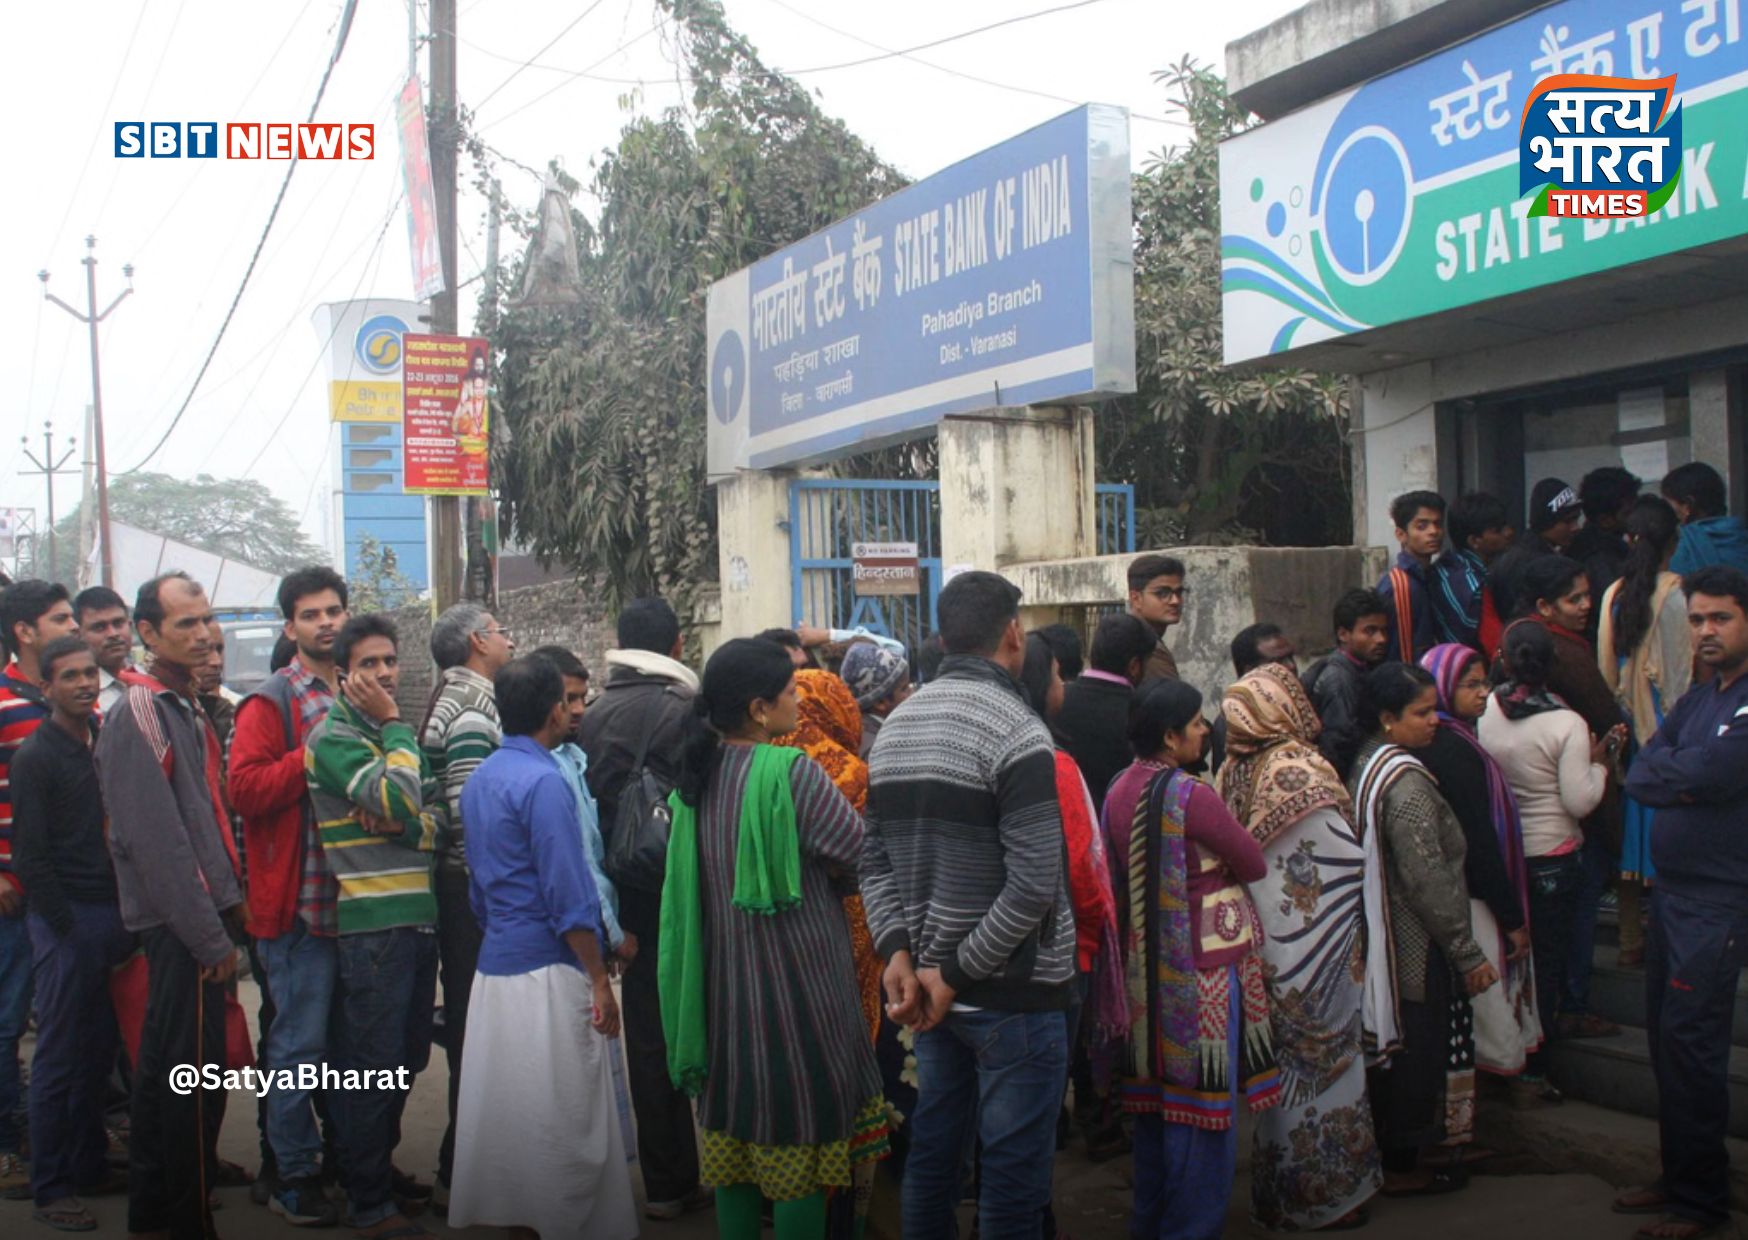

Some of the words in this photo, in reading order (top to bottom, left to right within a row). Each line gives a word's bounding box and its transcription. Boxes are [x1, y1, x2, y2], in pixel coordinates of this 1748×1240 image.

[1429, 60, 1512, 146] स्टेट
[894, 208, 940, 297] STATE
[944, 188, 988, 278] BANK
[994, 176, 1016, 261] OF
[1022, 153, 1072, 250] INDIA
[1435, 196, 1563, 281] STATE
[752, 256, 808, 352] भारतीय
[812, 234, 847, 329] स्टेट
[852, 218, 883, 311] बैंक
[922, 301, 984, 337] Pahadiya
[988, 279, 1042, 316] Branch
[822, 334, 860, 365] शाखा
[970, 324, 1017, 356] Varanasi
[853, 562, 915, 584] हिन्दुस्तान
